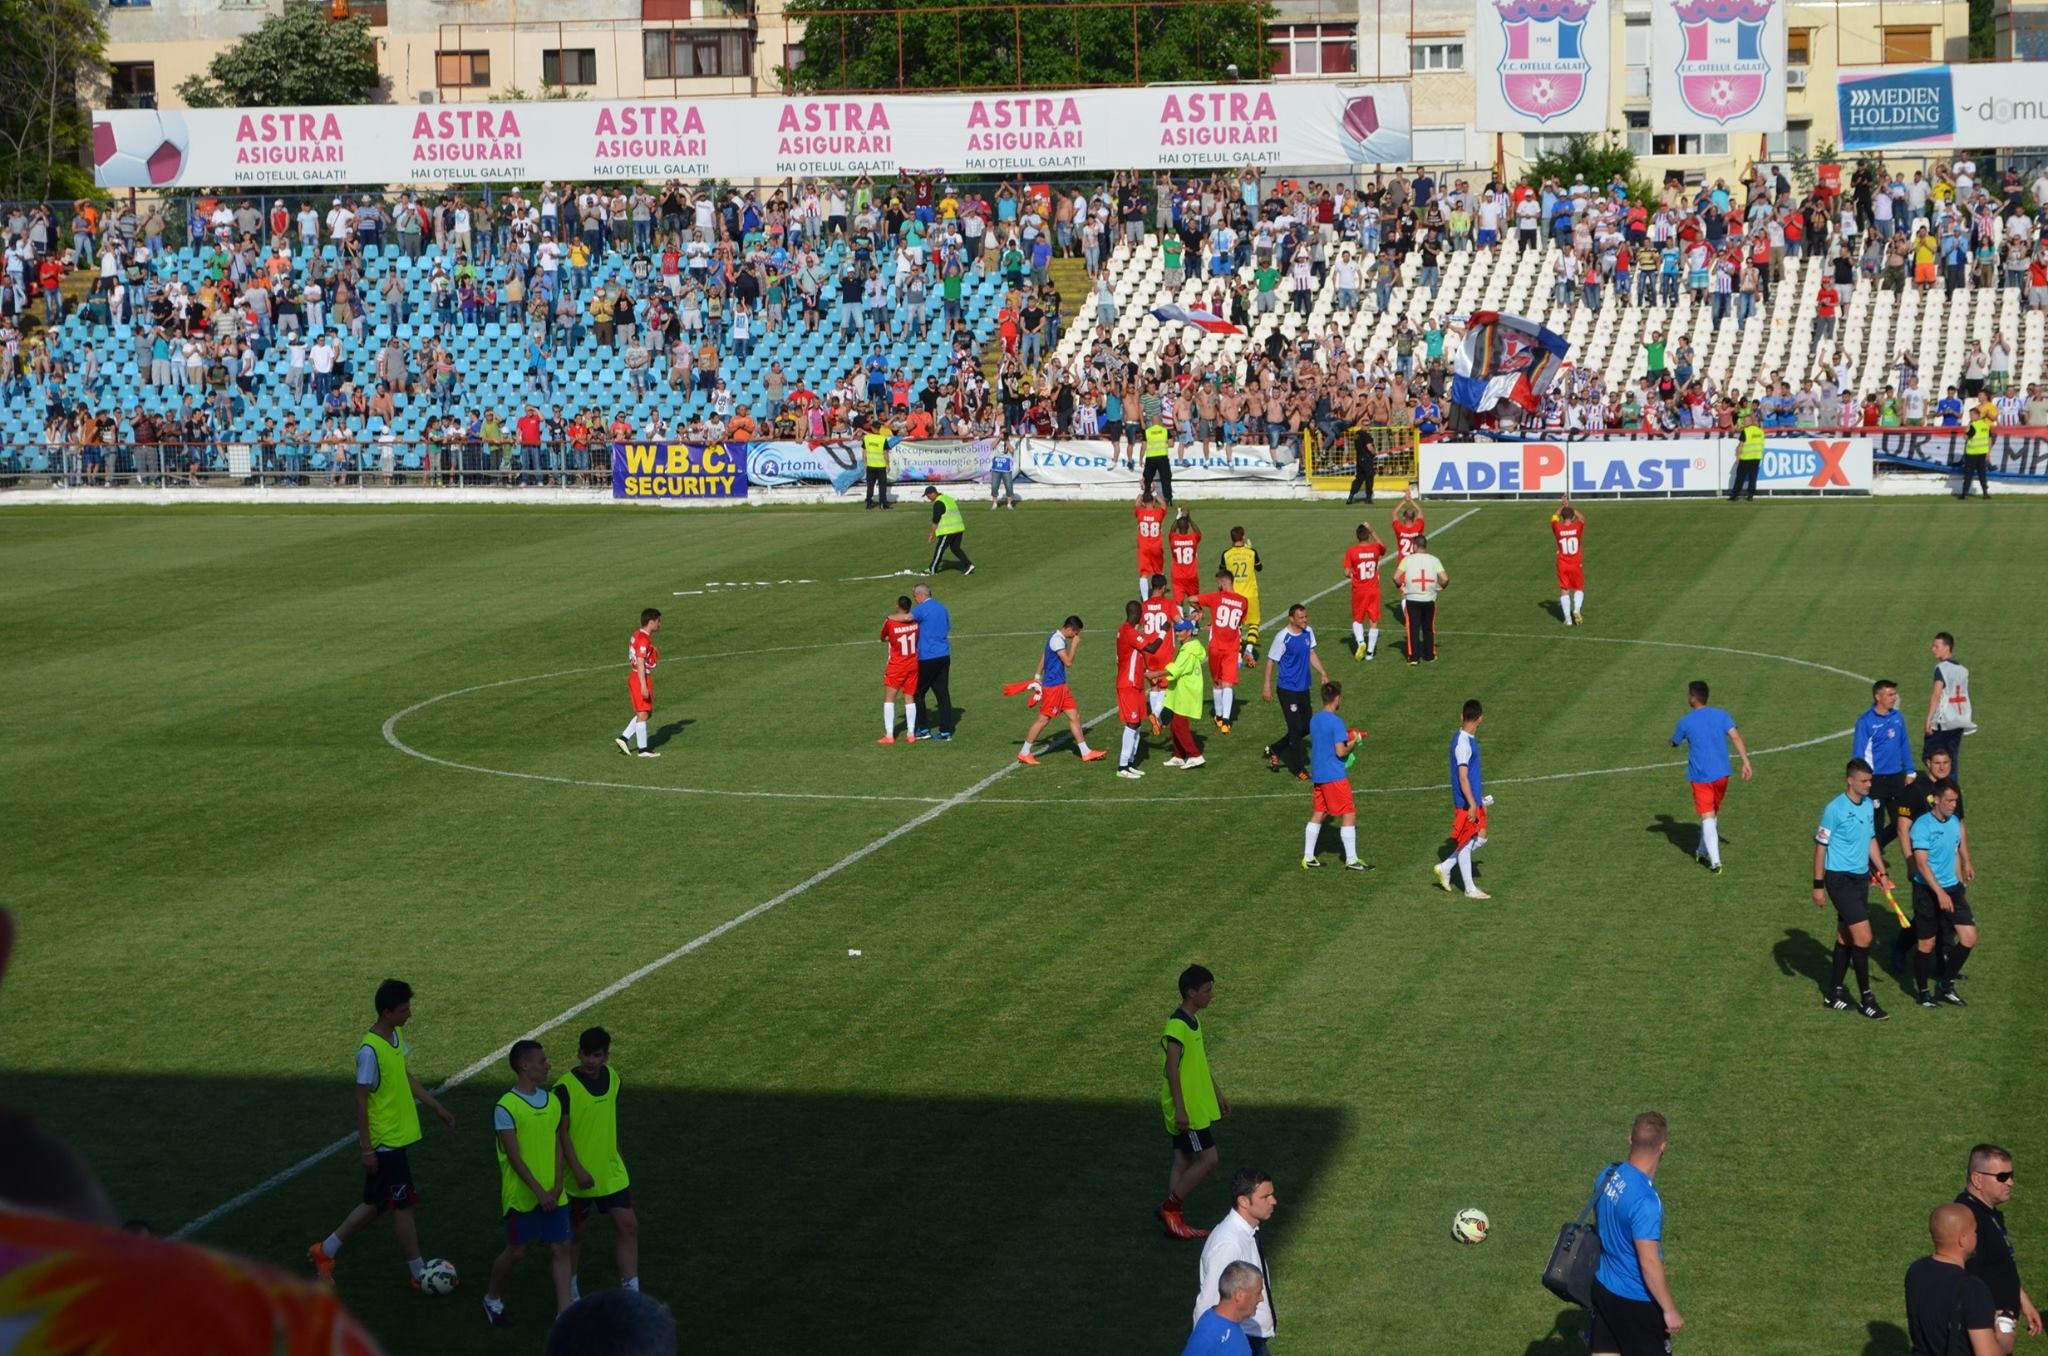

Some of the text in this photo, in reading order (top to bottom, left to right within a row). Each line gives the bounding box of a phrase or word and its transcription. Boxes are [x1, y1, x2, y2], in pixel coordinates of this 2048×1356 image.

[1871, 87, 1940, 106] MEDIEN
[778, 102, 890, 132] ASTRA
[968, 98, 1082, 128] ASTRA
[1160, 92, 1277, 123] ASTRA
[1851, 106, 1940, 125] HOLDING
[236, 113, 342, 142] ASTRA
[412, 110, 520, 139] ASTRA
[595, 106, 705, 136] ASTRA
[778, 131, 891, 154] ASIGURĂRI
[968, 125, 1083, 151] ASIGURĂRI
[1161, 121, 1278, 146] ASIGURĂRI
[236, 142, 344, 164] ASIGURĂRI
[413, 139, 522, 161] ASIGURĂRI
[595, 135, 706, 158] ASIGURĂRI
[777, 162, 796, 172] HAI
[966, 158, 986, 168] HAI
[1159, 154, 1178, 164] HAI
[235, 171, 253, 181] HAI
[411, 168, 428, 178] HAI
[594, 165, 612, 175] HAI
[625, 445, 736, 474] W.B.C.
[895, 446, 953, 456] Recuperare,
[903, 457, 972, 468] Traumatologie
[624, 475, 736, 496] SECURITY
[1173, 547, 1194, 564] 18
[1400, 538, 1413, 555] 2
[1558, 537, 1579, 555] 10
[1233, 562, 1248, 578] 22
[1357, 561, 1376, 580] 13
[1144, 612, 1168, 635] 30
[1216, 605, 1243, 630] 96
[897, 633, 916, 656] 11
